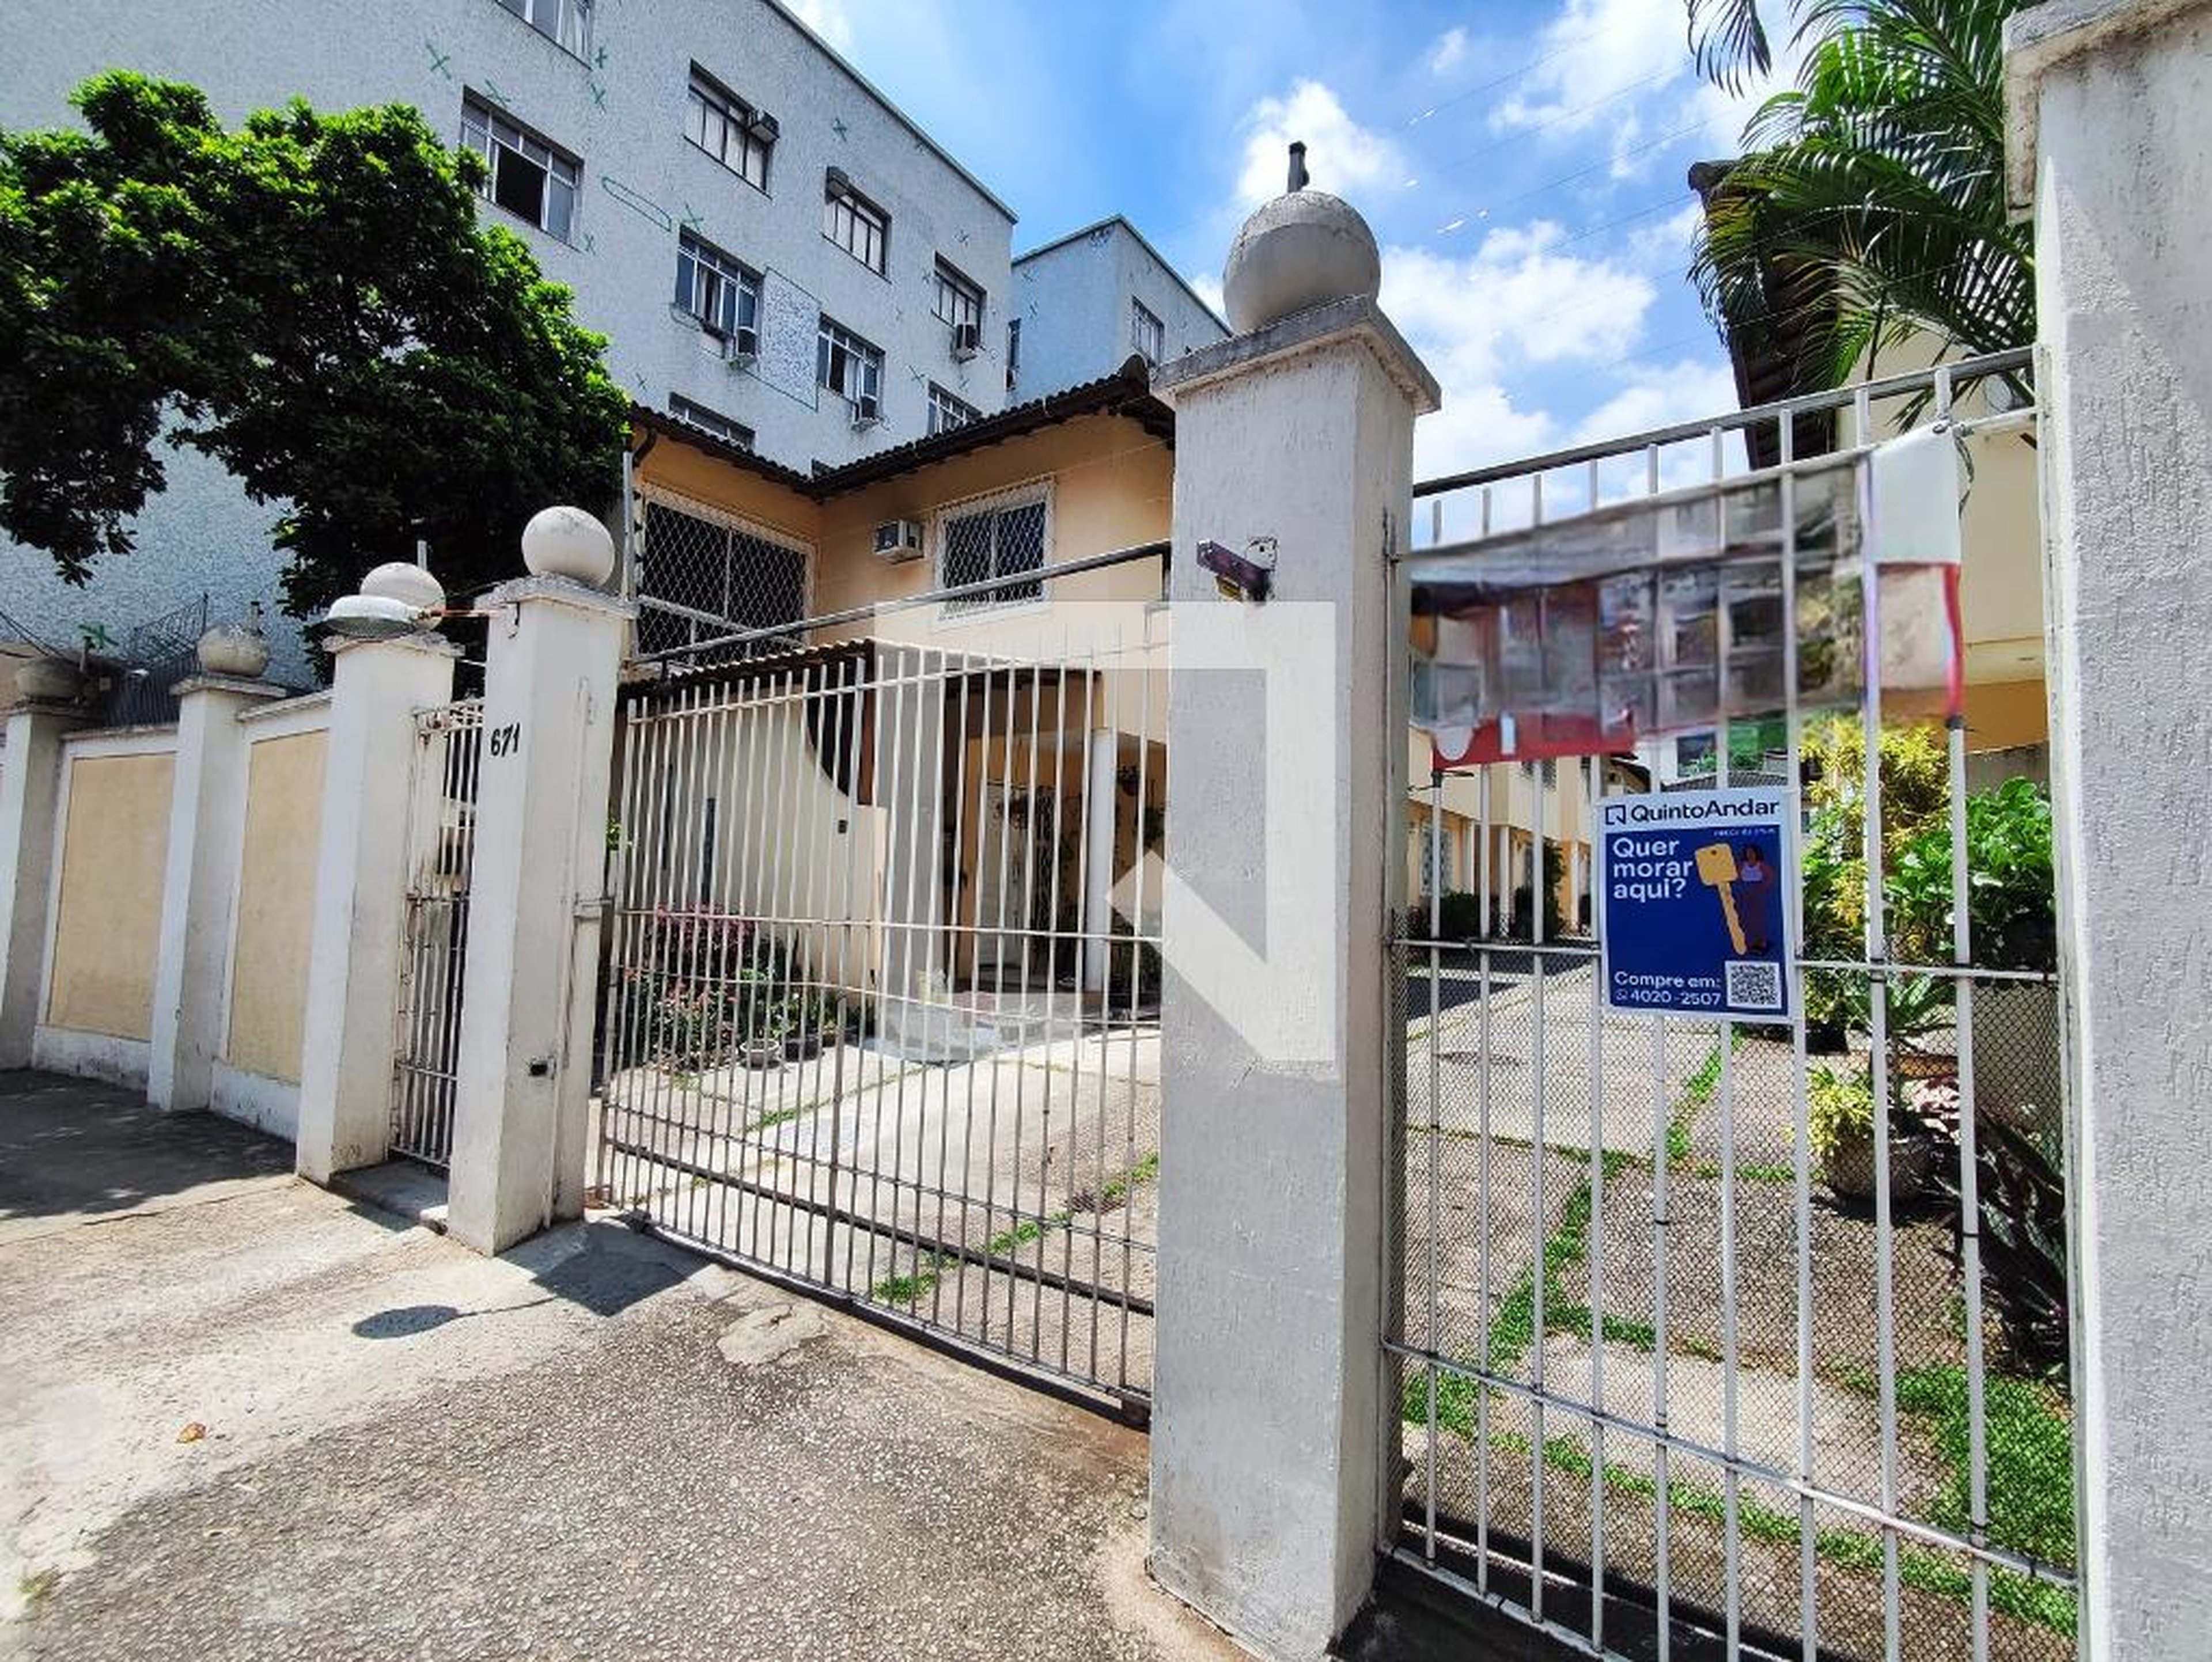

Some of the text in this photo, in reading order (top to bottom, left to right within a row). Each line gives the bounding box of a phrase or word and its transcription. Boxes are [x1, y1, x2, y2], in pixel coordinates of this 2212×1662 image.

[491, 722, 520, 757] 671
[1631, 798, 1780, 822] QuintoAndar
[1613, 837, 1679, 859] Quer
[1614, 862, 1693, 878] morar
[1613, 878, 1686, 903] aqui?
[1615, 971, 1685, 989] Compre
